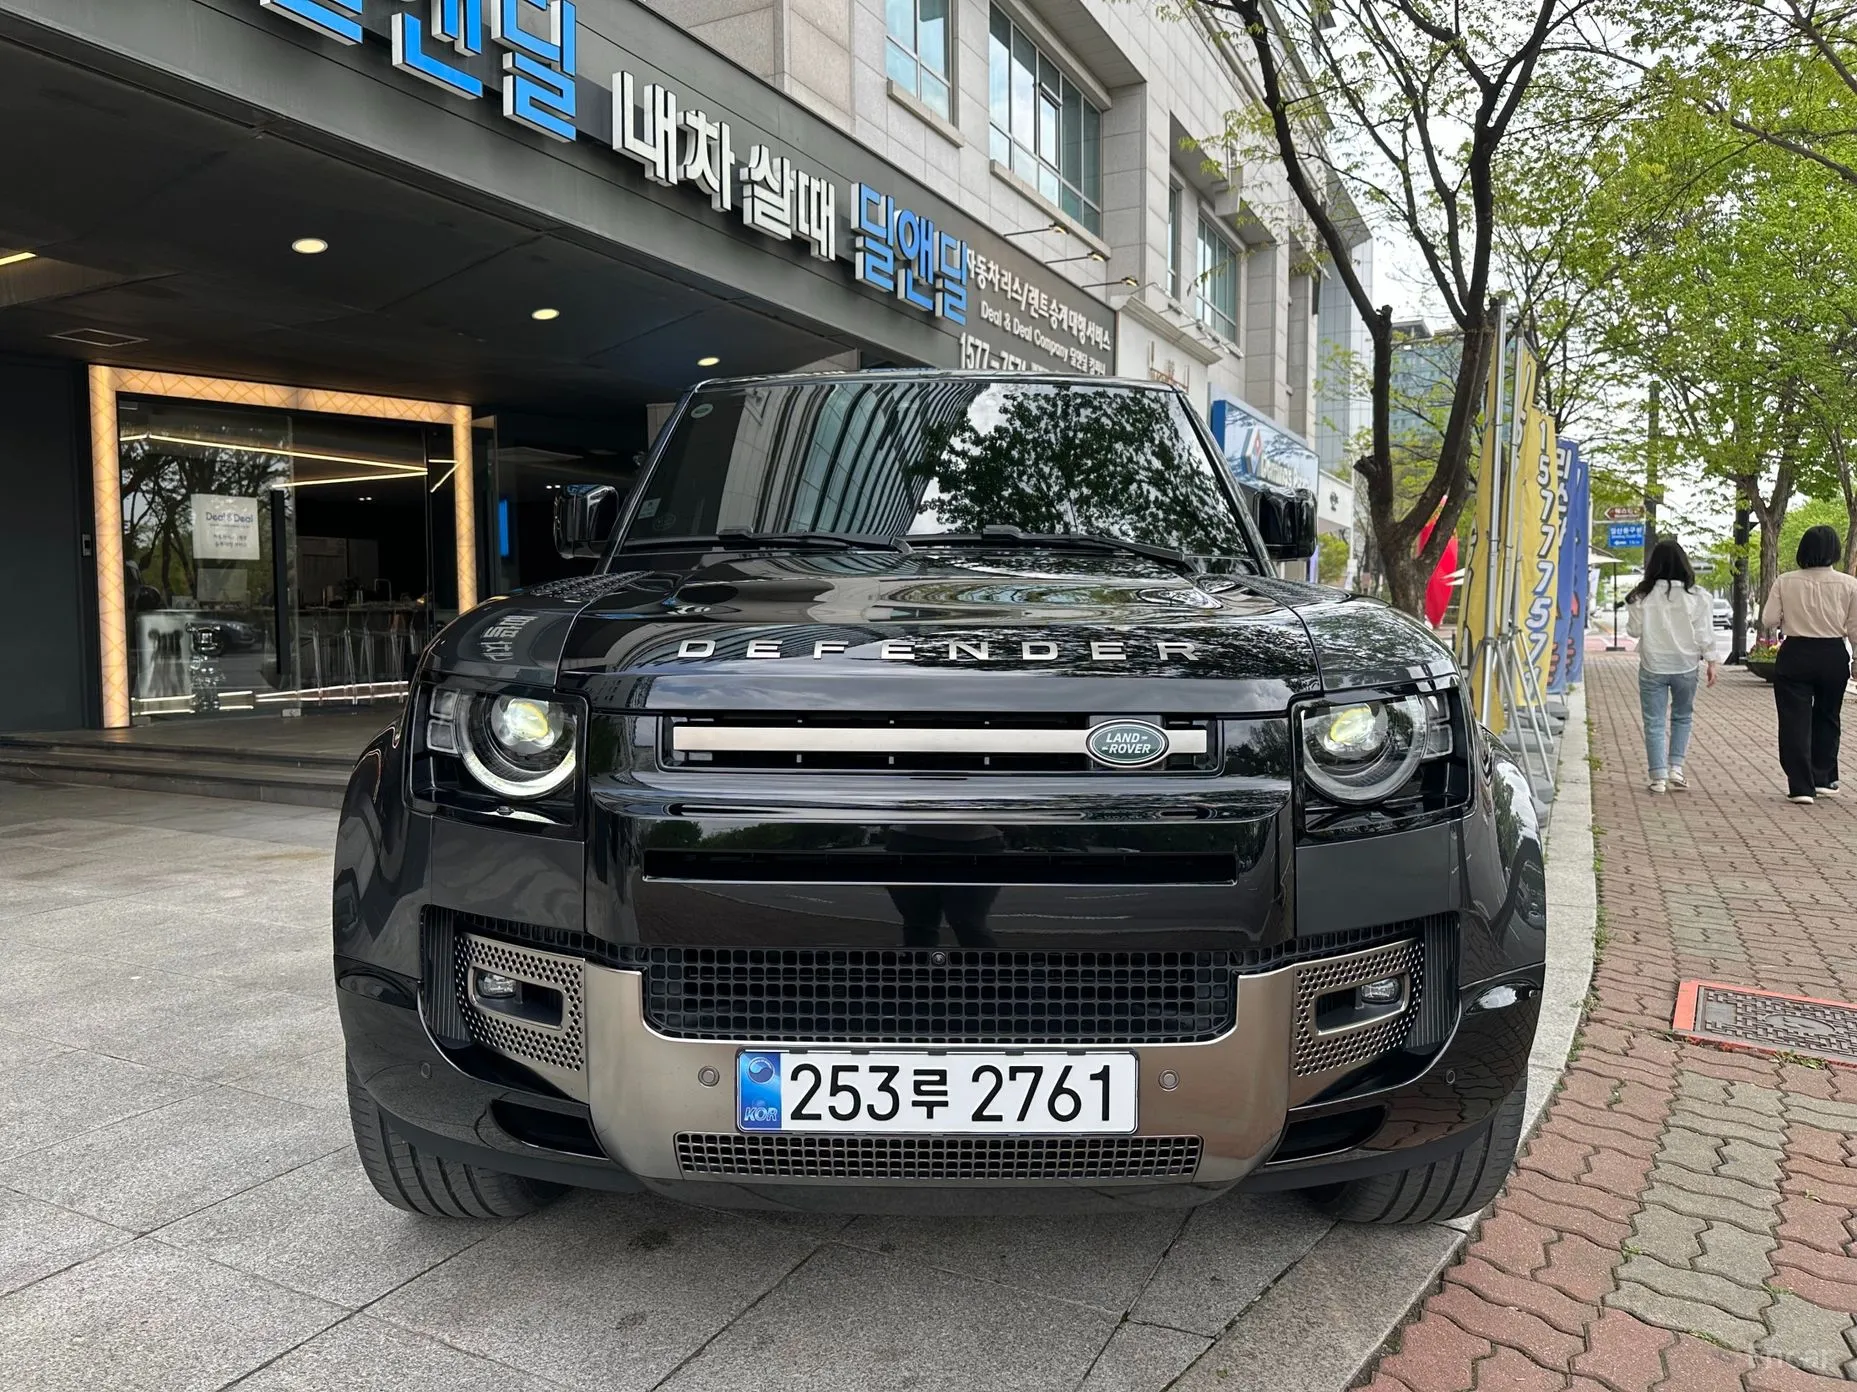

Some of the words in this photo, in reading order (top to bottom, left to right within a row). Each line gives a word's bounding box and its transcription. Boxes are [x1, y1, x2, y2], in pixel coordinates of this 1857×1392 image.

[851, 182, 968, 326] 딜앤딜
[981, 301, 1002, 327] Deal
[1004, 313, 1011, 331] &
[1013, 317, 1033, 342] Deal
[1034, 329, 1069, 362] Company
[677, 640, 1201, 661] DEFENDER
[744, 1107, 778, 1121] KOR
[790, 1064, 948, 1121] 253루
[971, 1065, 1110, 1122] 2761
